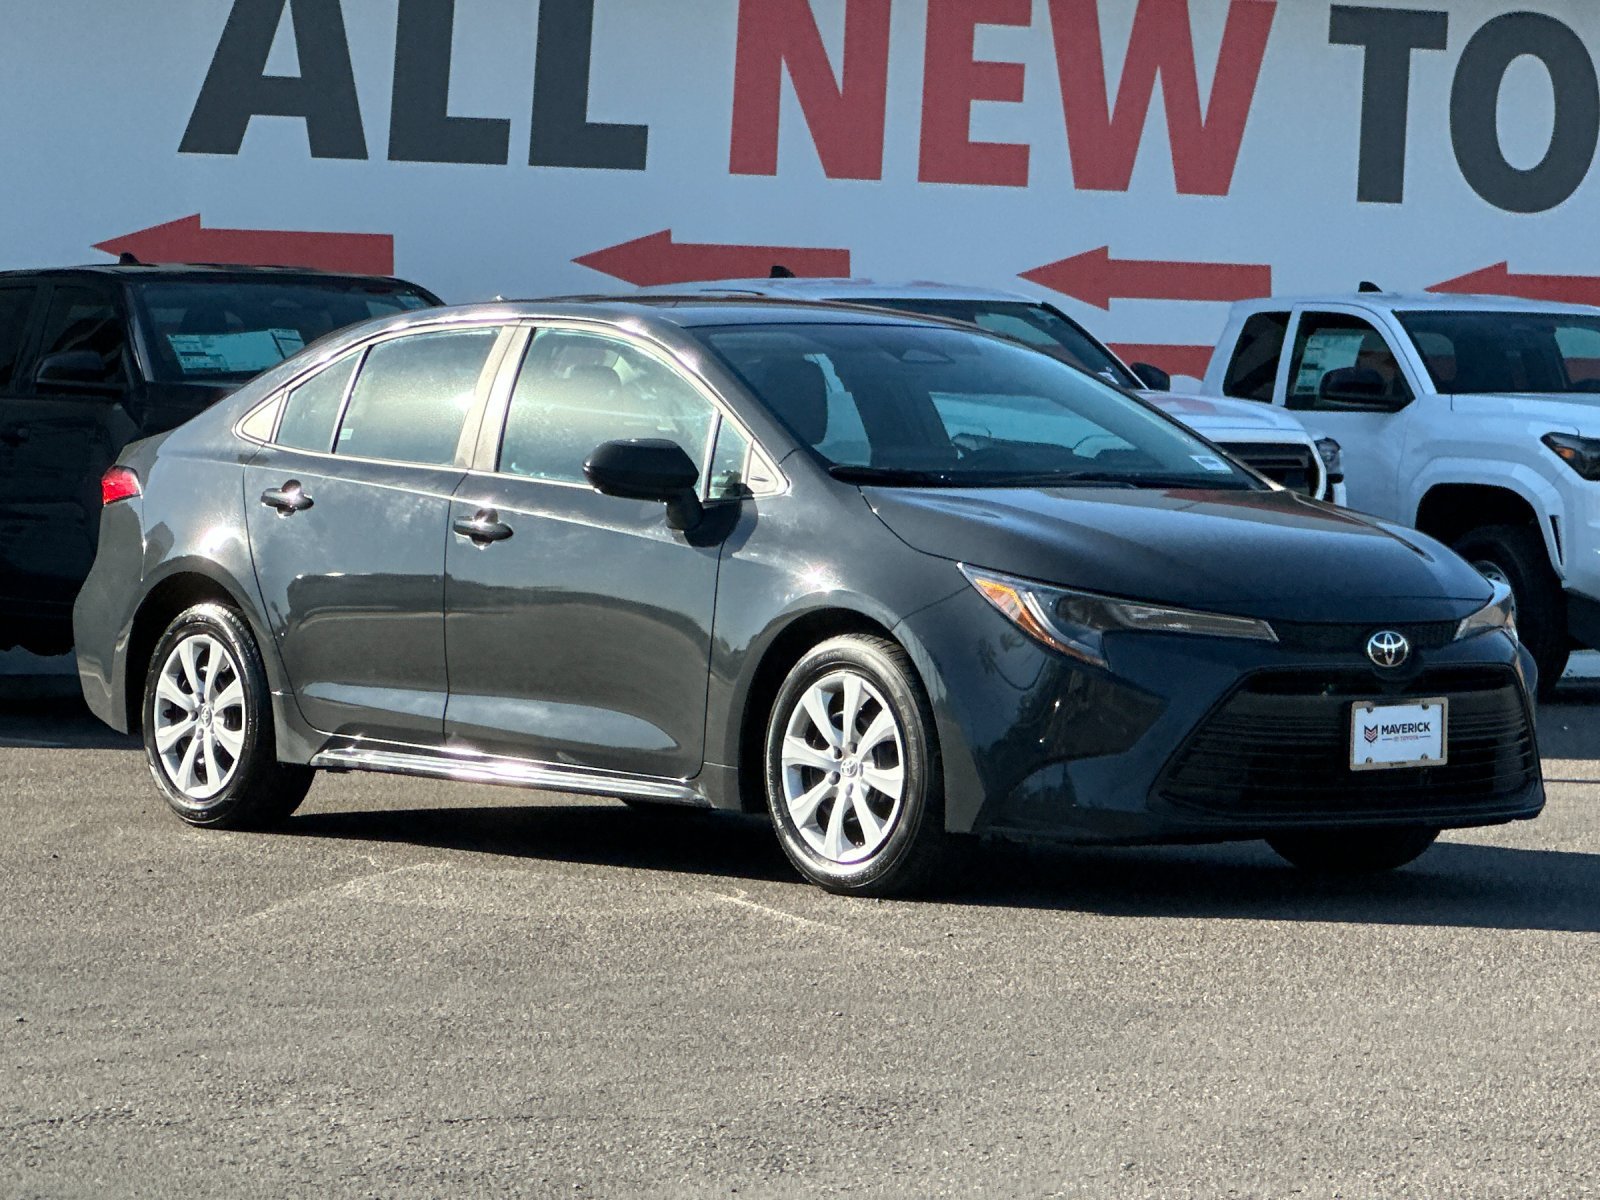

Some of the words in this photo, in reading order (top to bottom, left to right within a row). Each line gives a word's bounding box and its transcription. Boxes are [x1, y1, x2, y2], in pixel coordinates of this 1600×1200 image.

[178, 0, 648, 170] ALL
[729, 0, 1277, 196] NEW
[1329, 4, 1600, 214] TO
[1381, 722, 1431, 734] MAVERICK
